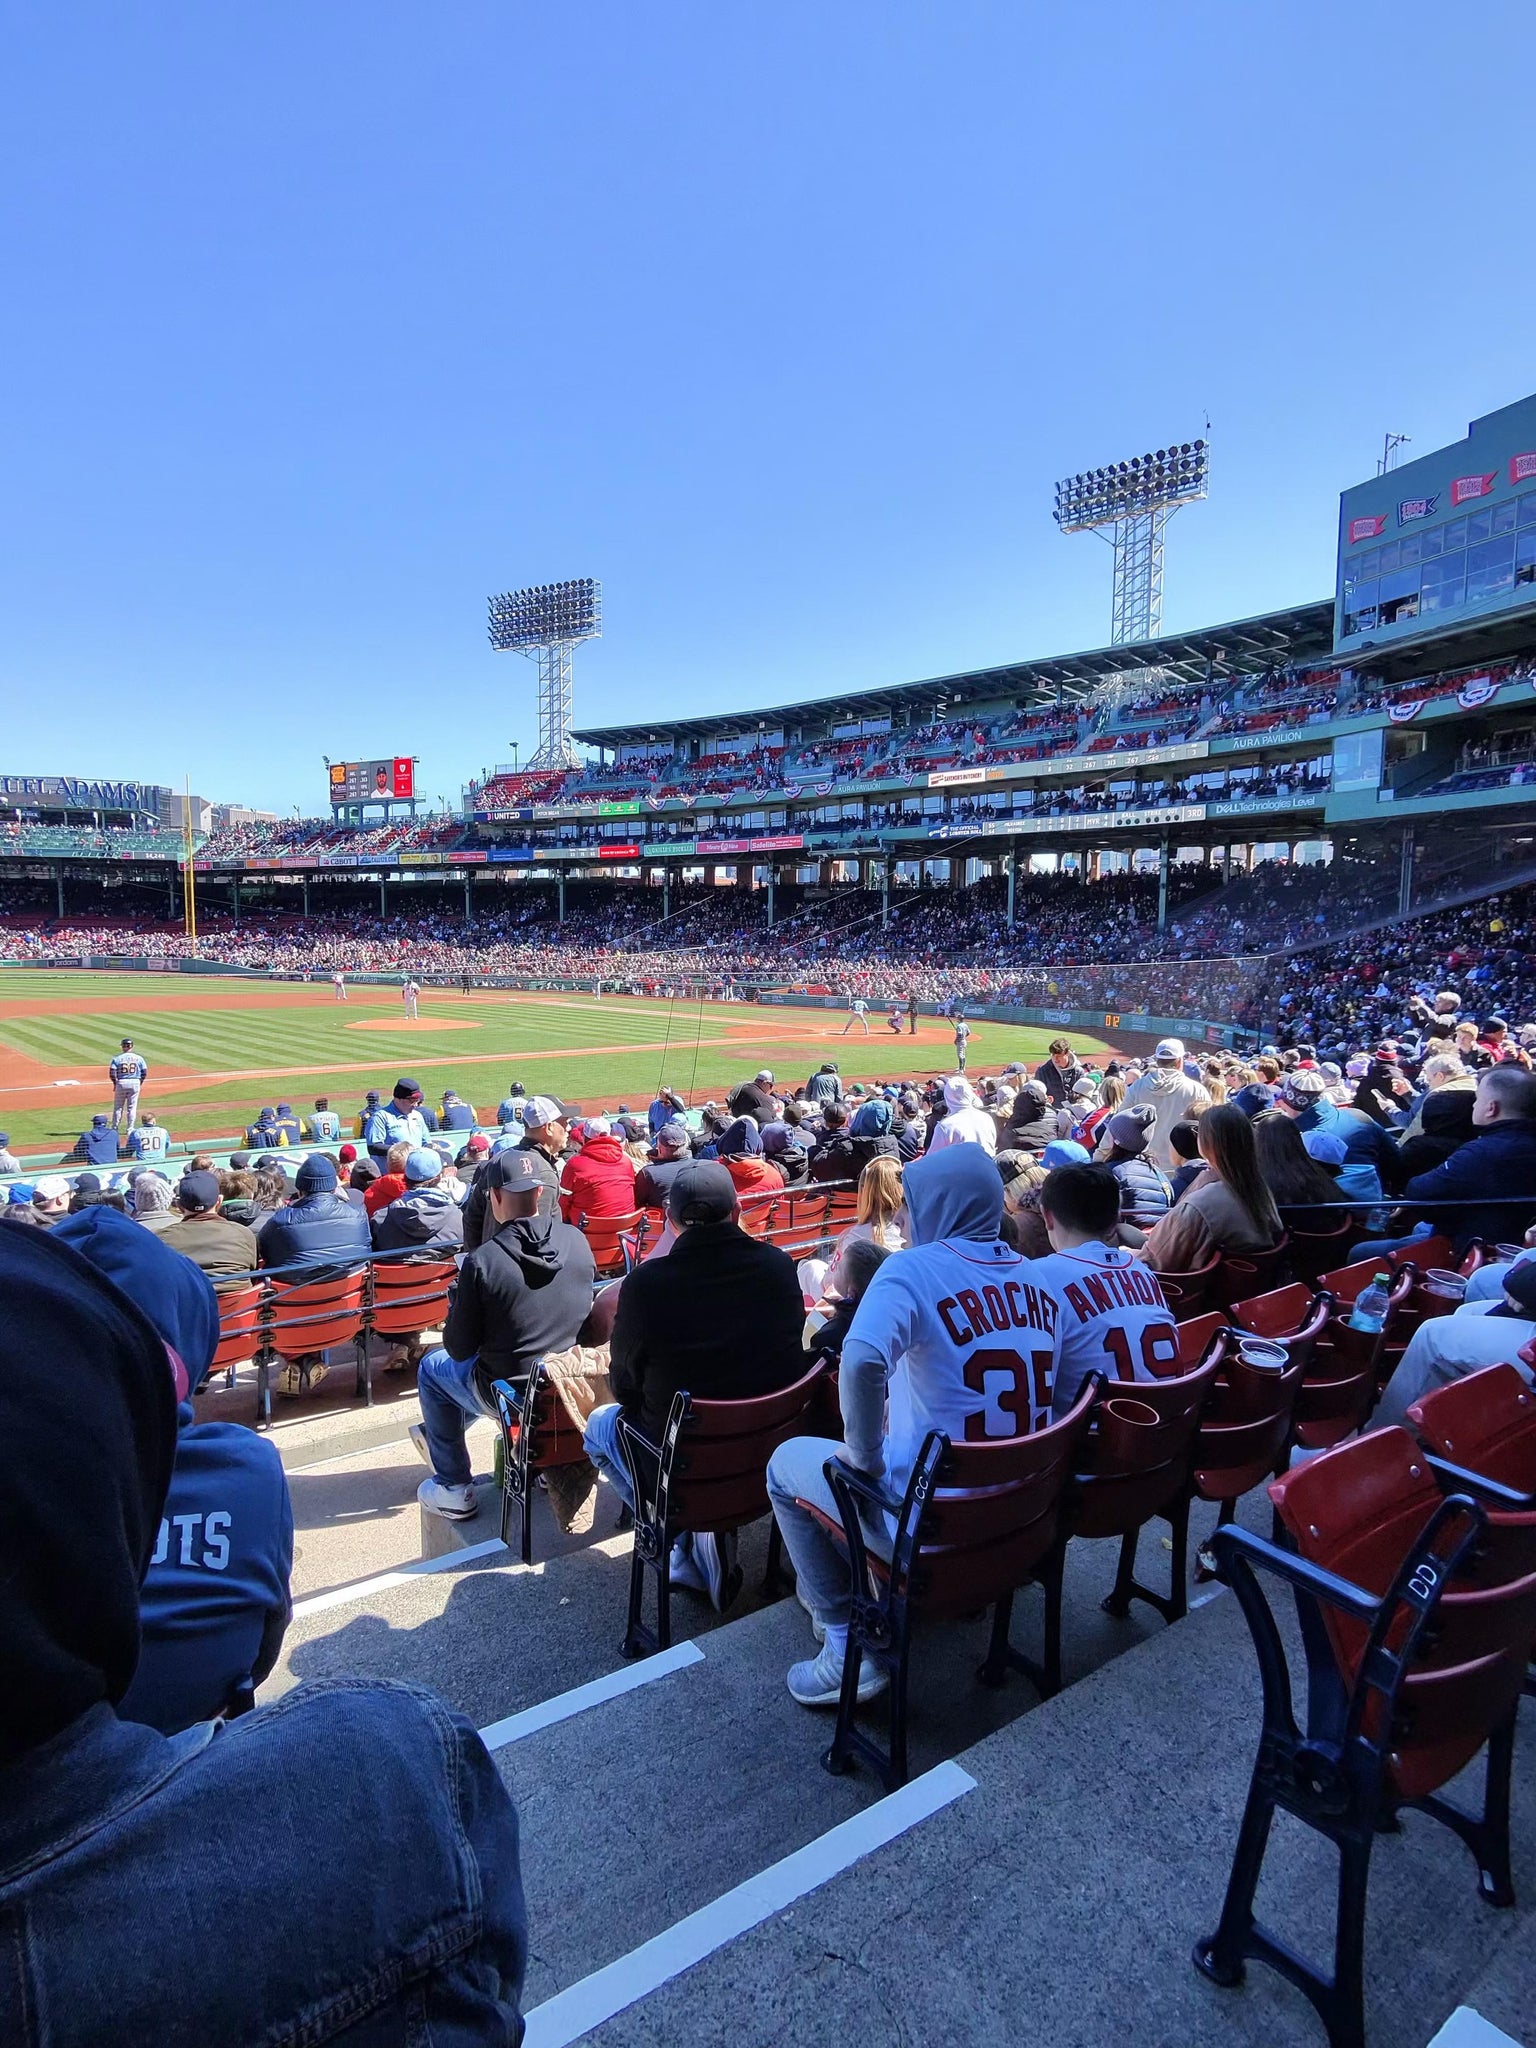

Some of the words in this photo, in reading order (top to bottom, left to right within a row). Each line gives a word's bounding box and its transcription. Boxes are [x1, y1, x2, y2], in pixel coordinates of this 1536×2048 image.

[1262, 732, 1301, 744] PAVILION
[0, 777, 51, 794] UEL
[56, 776, 139, 800] ADAMS
[856, 783, 880, 792] PAVILION
[1293, 796, 1315, 807] Level
[1187, 809, 1202, 817] 3RD
[322, 1123, 330, 1136] 6
[141, 1137, 161, 1150] 20
[1063, 1270, 1168, 1324] ANTHON
[915, 1476, 928, 1500] CC
[1408, 1564, 1437, 1599] DD
